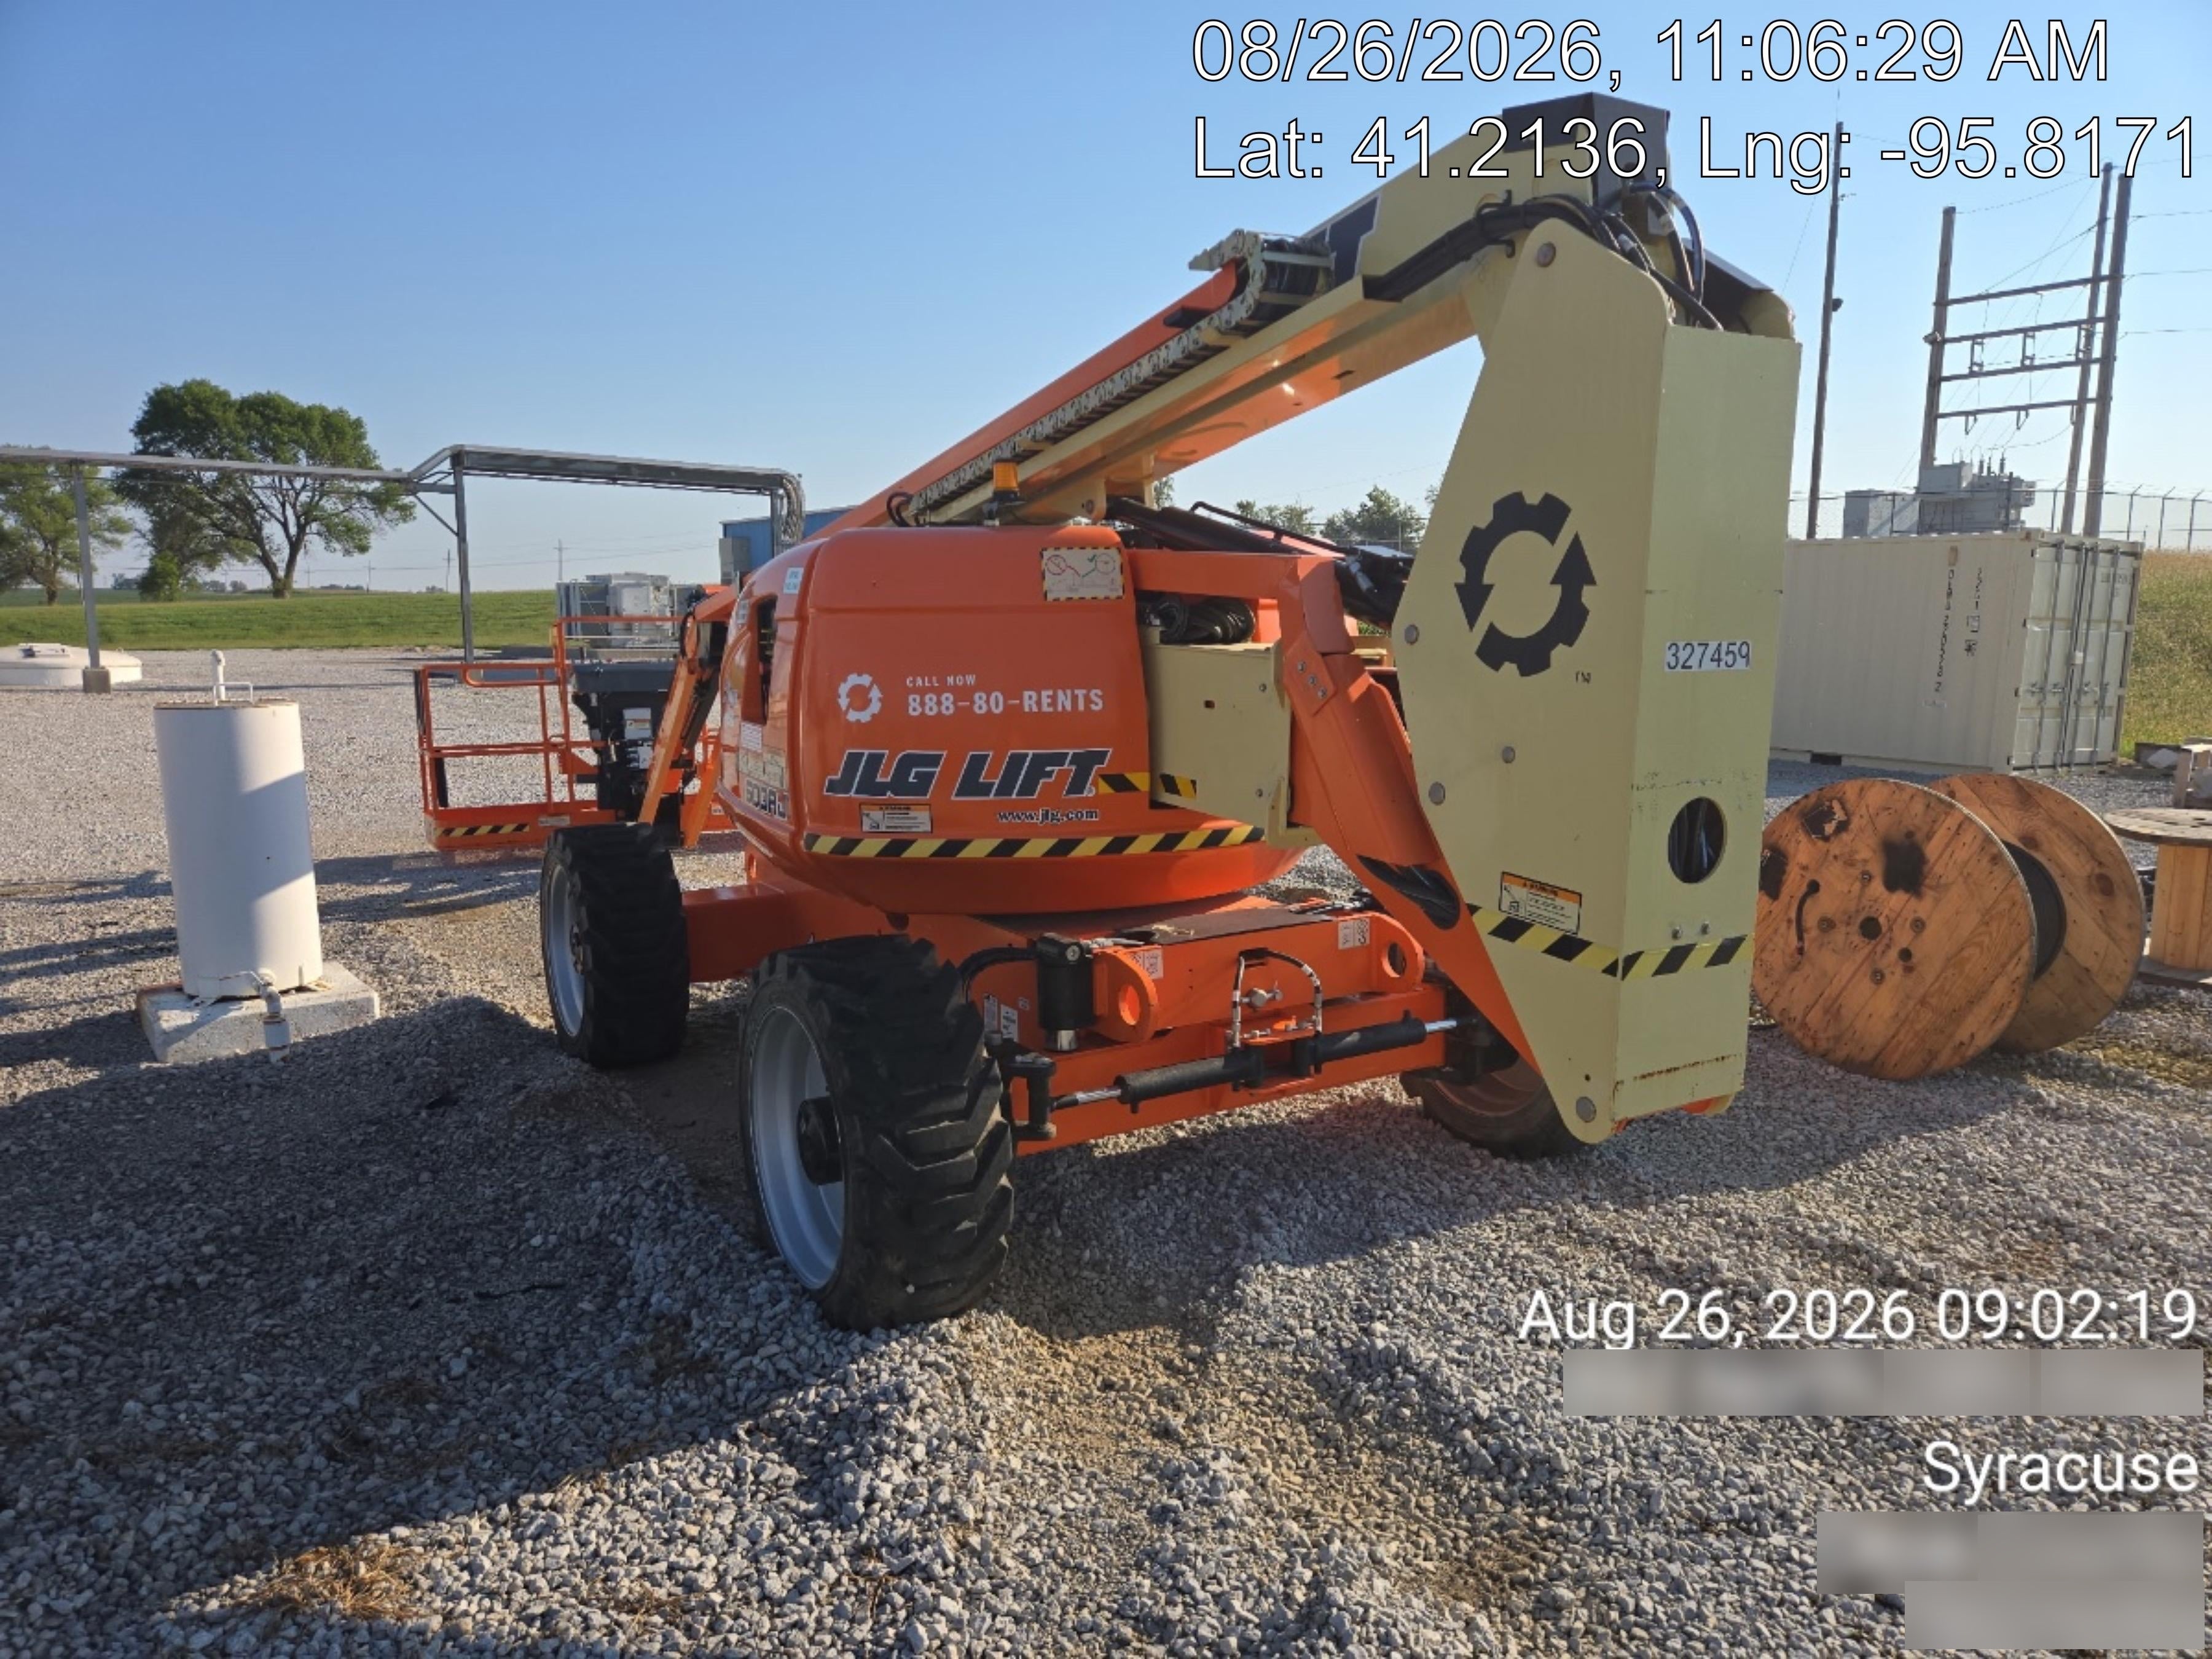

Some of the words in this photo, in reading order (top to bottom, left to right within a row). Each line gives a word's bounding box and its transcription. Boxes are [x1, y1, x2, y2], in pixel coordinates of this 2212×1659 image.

[1667, 641, 1750, 669] 327459
[906, 676, 939, 687] CALL
[947, 675, 976, 686] NOW
[908, 689, 1104, 716] 888-80-RENTS
[823, 750, 947, 798] JLG
[951, 748, 1113, 800] LIFT
[998, 809, 1099, 824] www.jlg.com
